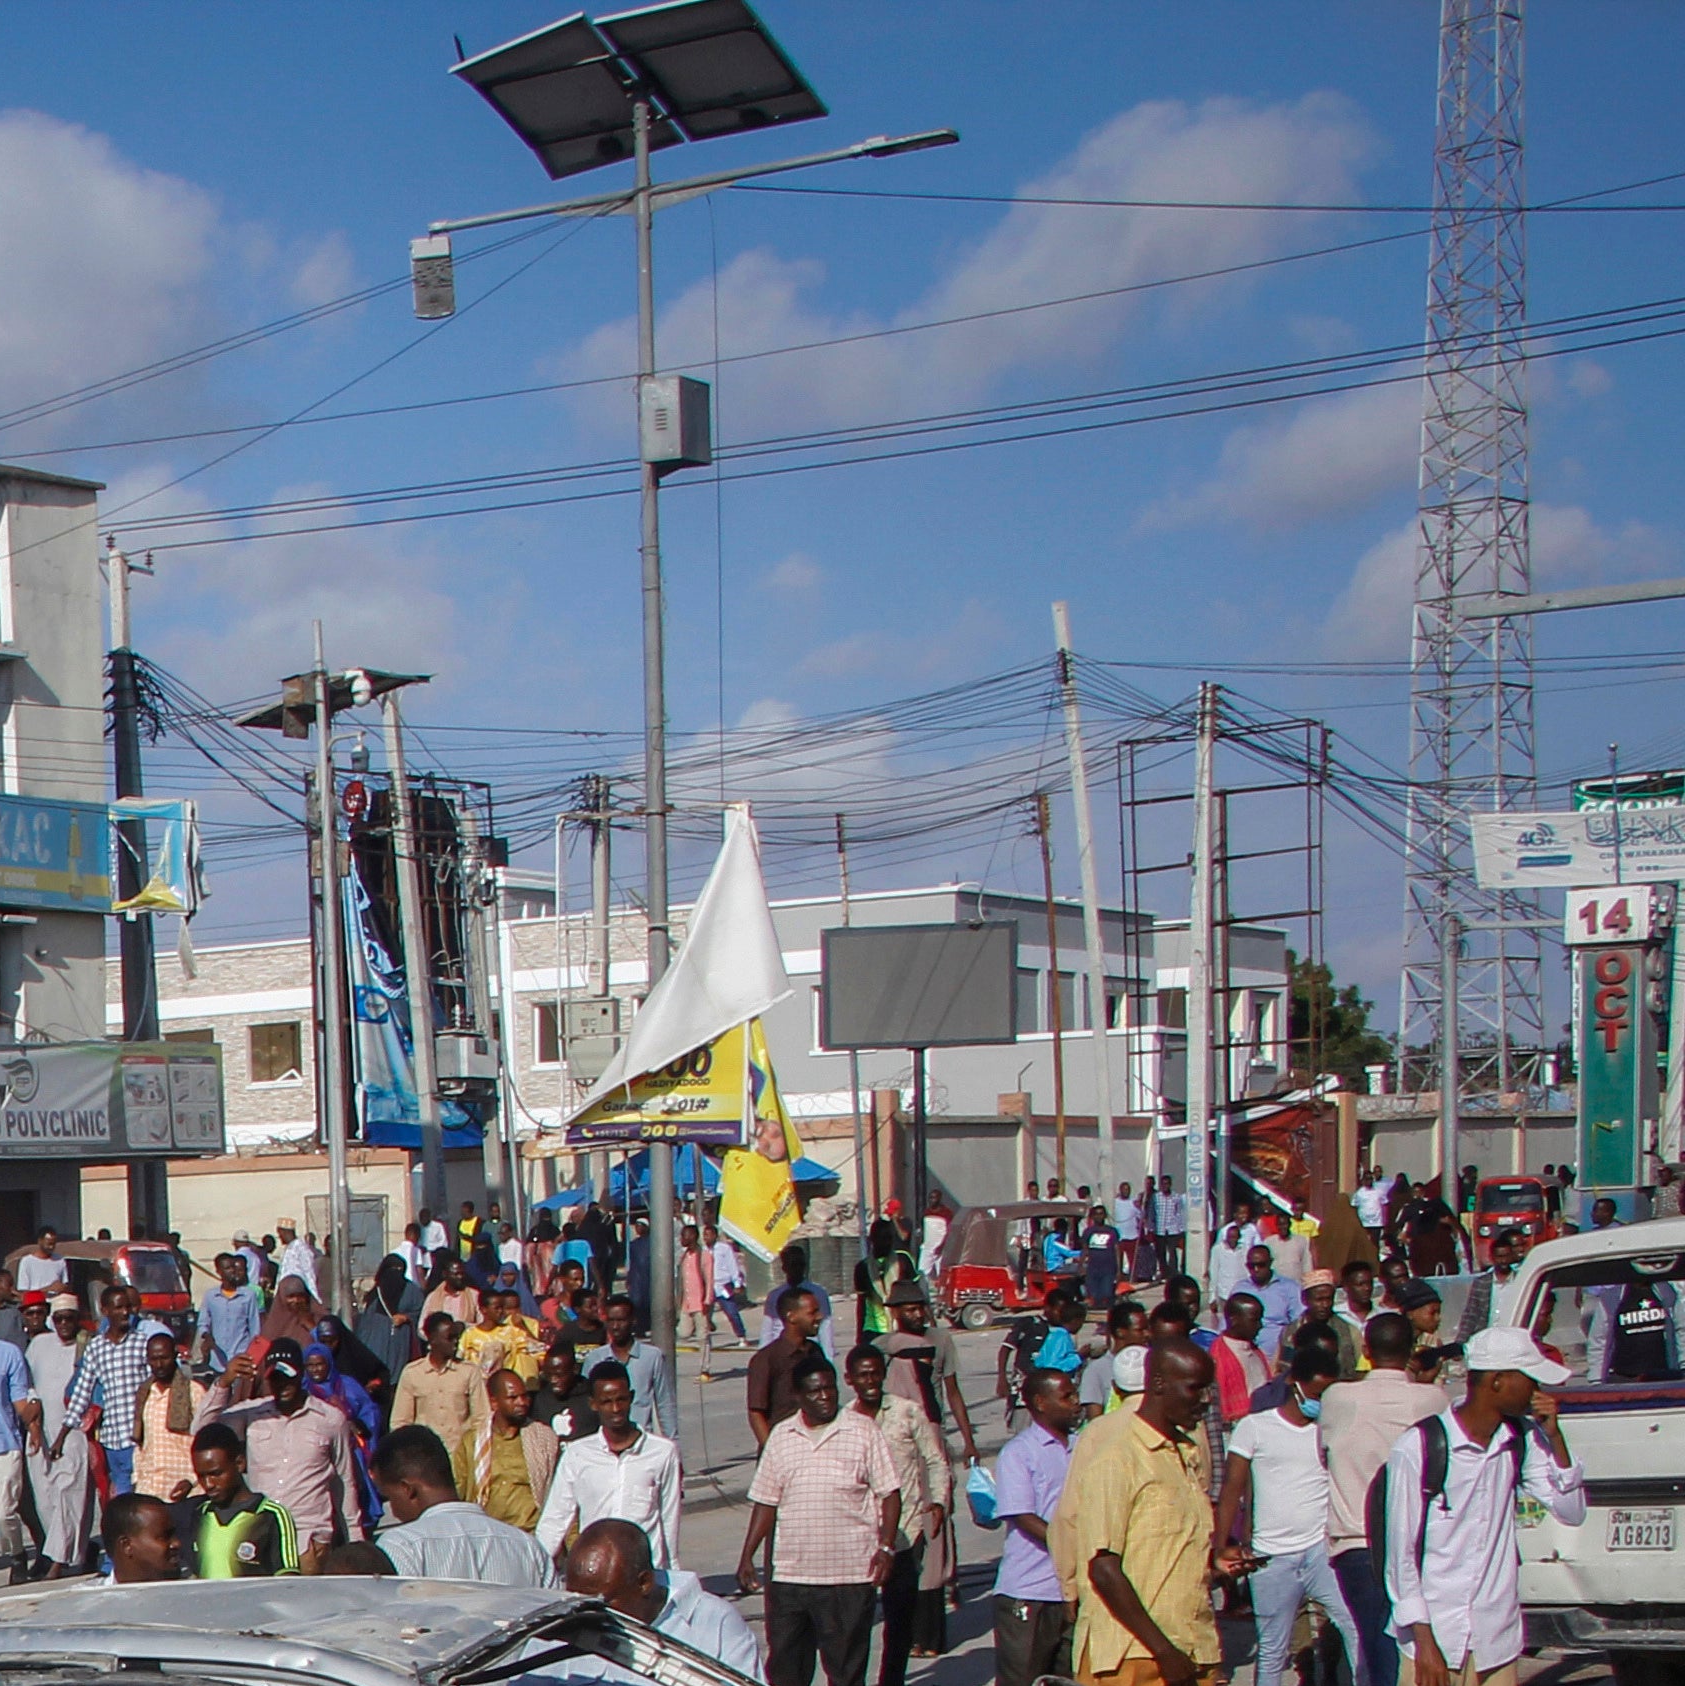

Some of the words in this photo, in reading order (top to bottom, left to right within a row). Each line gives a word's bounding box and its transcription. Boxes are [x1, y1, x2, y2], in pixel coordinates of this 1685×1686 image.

[1578, 898, 1632, 935] 14
[1594, 952, 1630, 1054] OCT
[5, 1110, 107, 1138] POLYCLINIC
